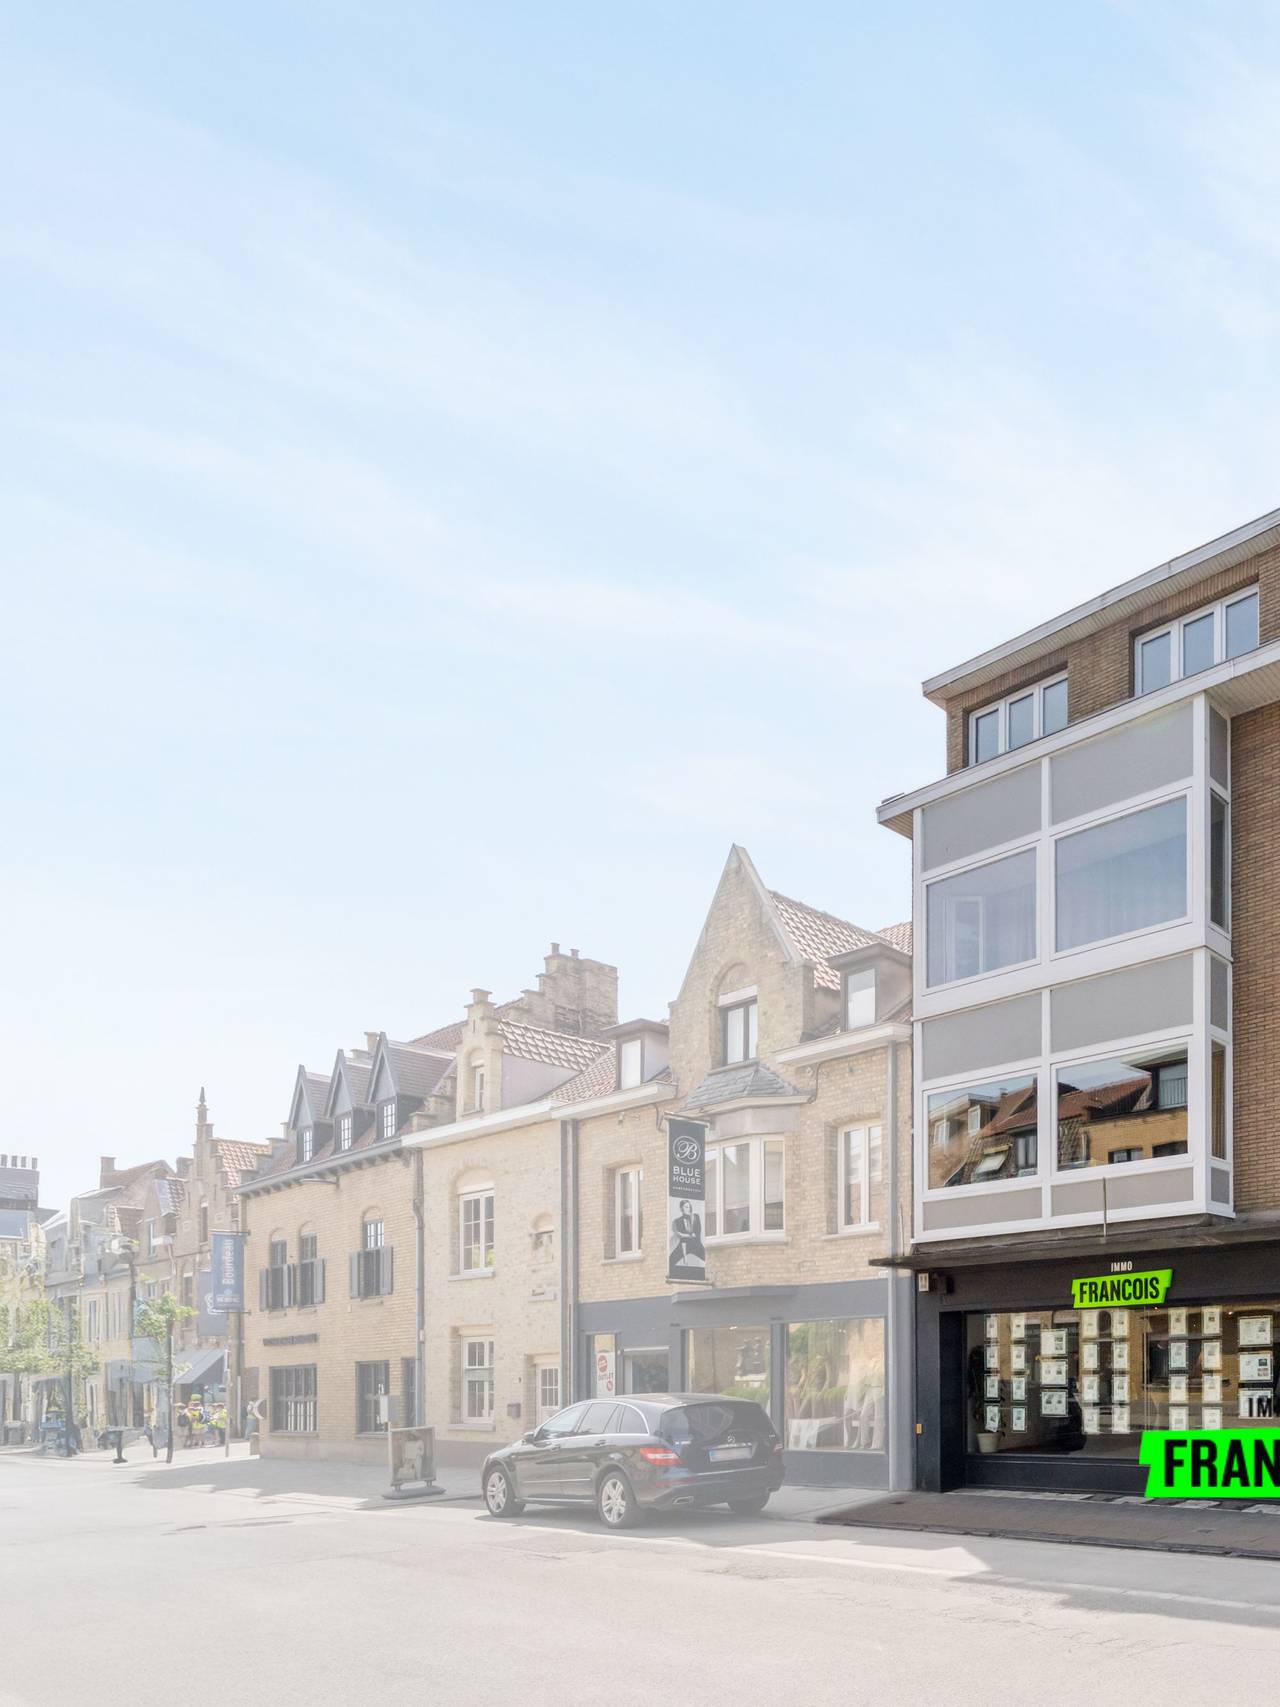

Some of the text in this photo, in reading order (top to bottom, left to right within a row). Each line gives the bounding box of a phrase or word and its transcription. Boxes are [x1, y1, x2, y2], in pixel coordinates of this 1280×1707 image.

[673, 1166, 701, 1178] BLUE
[673, 1175, 701, 1185] HOUSE
[222, 1239, 235, 1285] Bourdeau
[1111, 1261, 1133, 1273] IMMO
[1080, 1276, 1160, 1303] FRANCOIS
